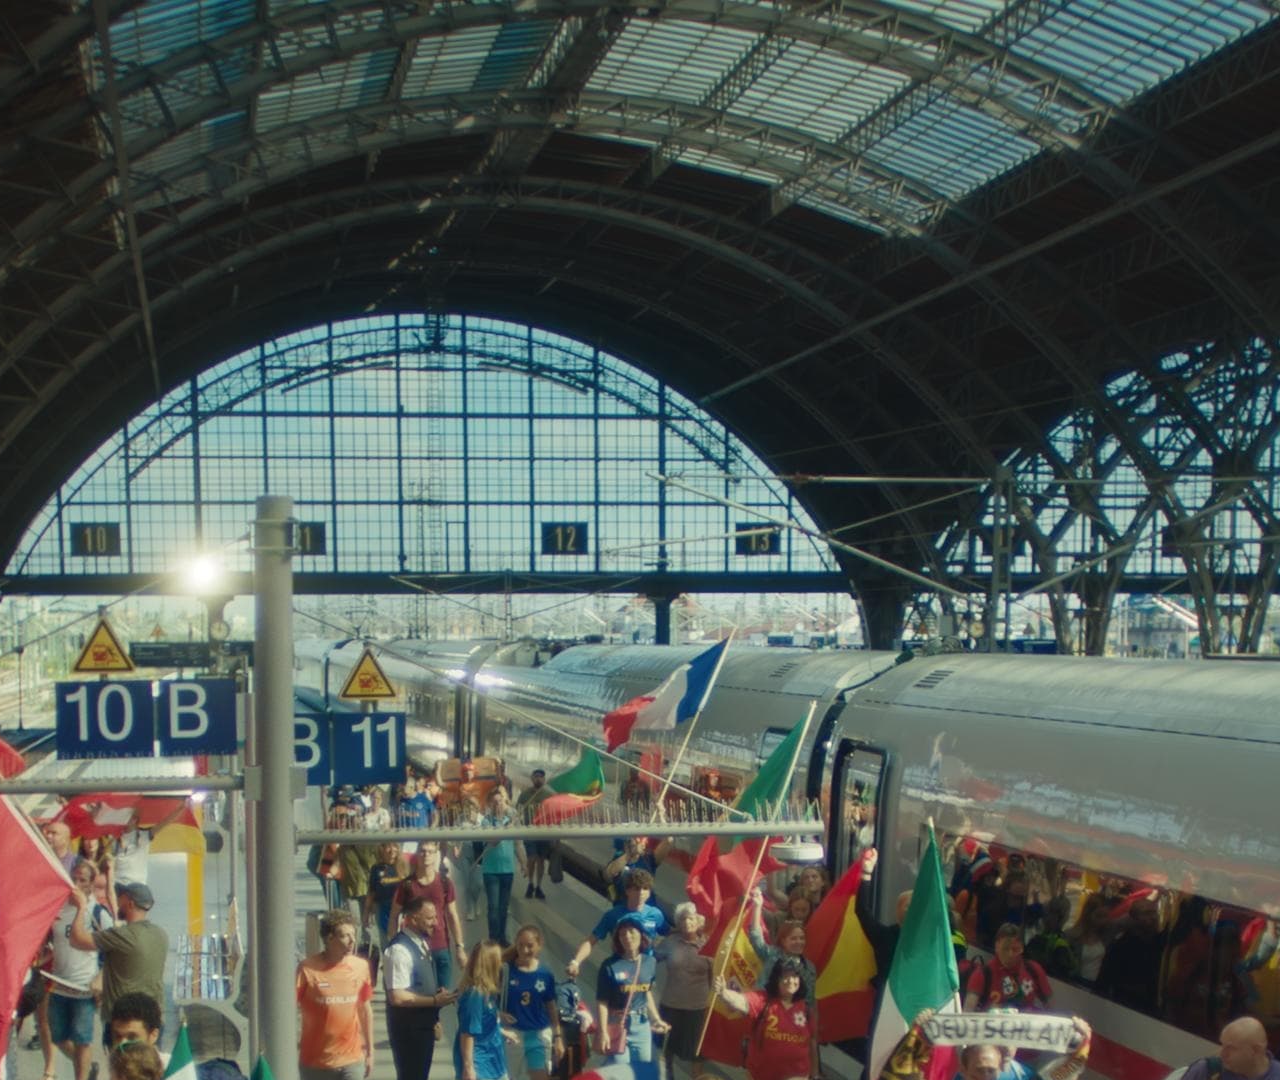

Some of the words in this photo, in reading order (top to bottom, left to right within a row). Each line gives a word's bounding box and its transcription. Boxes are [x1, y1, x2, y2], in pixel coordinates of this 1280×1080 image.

[84, 527, 106, 553] 10
[555, 526, 576, 551] 12
[65, 684, 135, 742] 10
[169, 682, 210, 740] B
[351, 716, 398, 769] 11
[766, 1014, 779, 1031] 2
[926, 1018, 1073, 1047] DEUTSCHLAN
